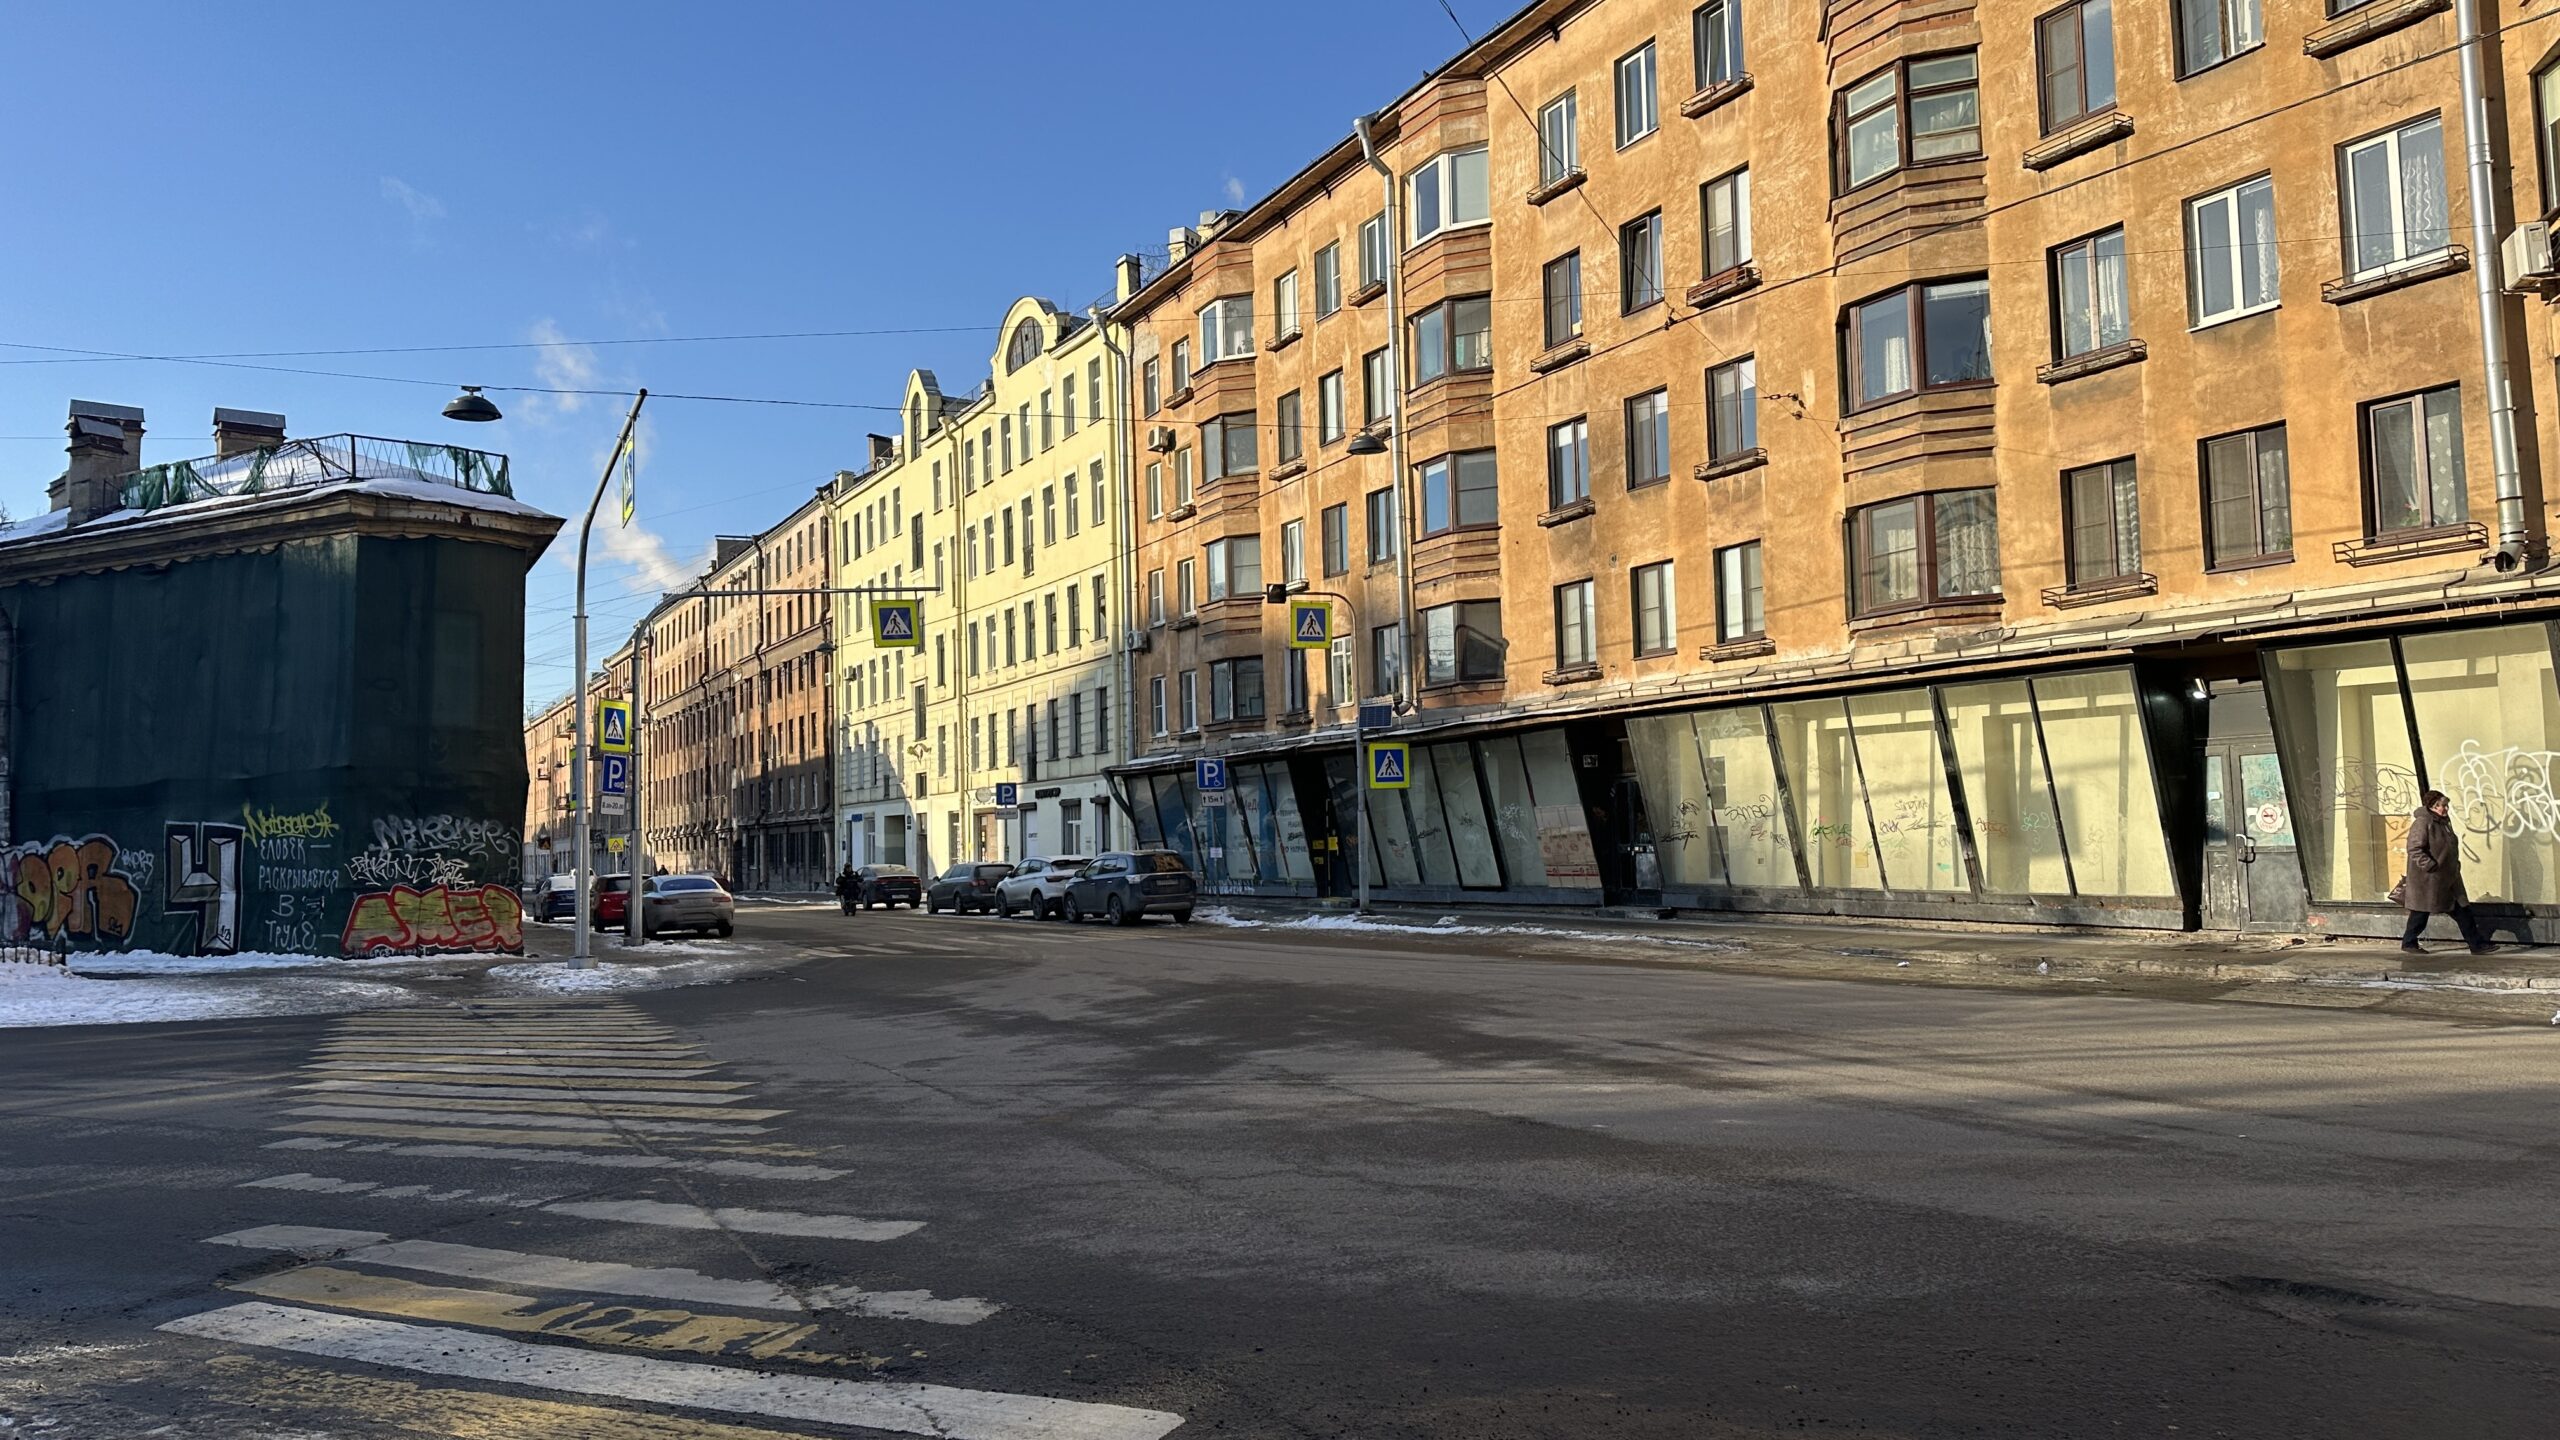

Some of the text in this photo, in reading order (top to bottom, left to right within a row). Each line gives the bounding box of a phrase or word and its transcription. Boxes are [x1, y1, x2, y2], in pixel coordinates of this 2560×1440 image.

[608, 760, 622, 789] P
[1204, 763, 1218, 785] P
[1002, 785, 1013, 802] P
[258, 865, 340, 894] РАСКРЫВАЕТСЯ
